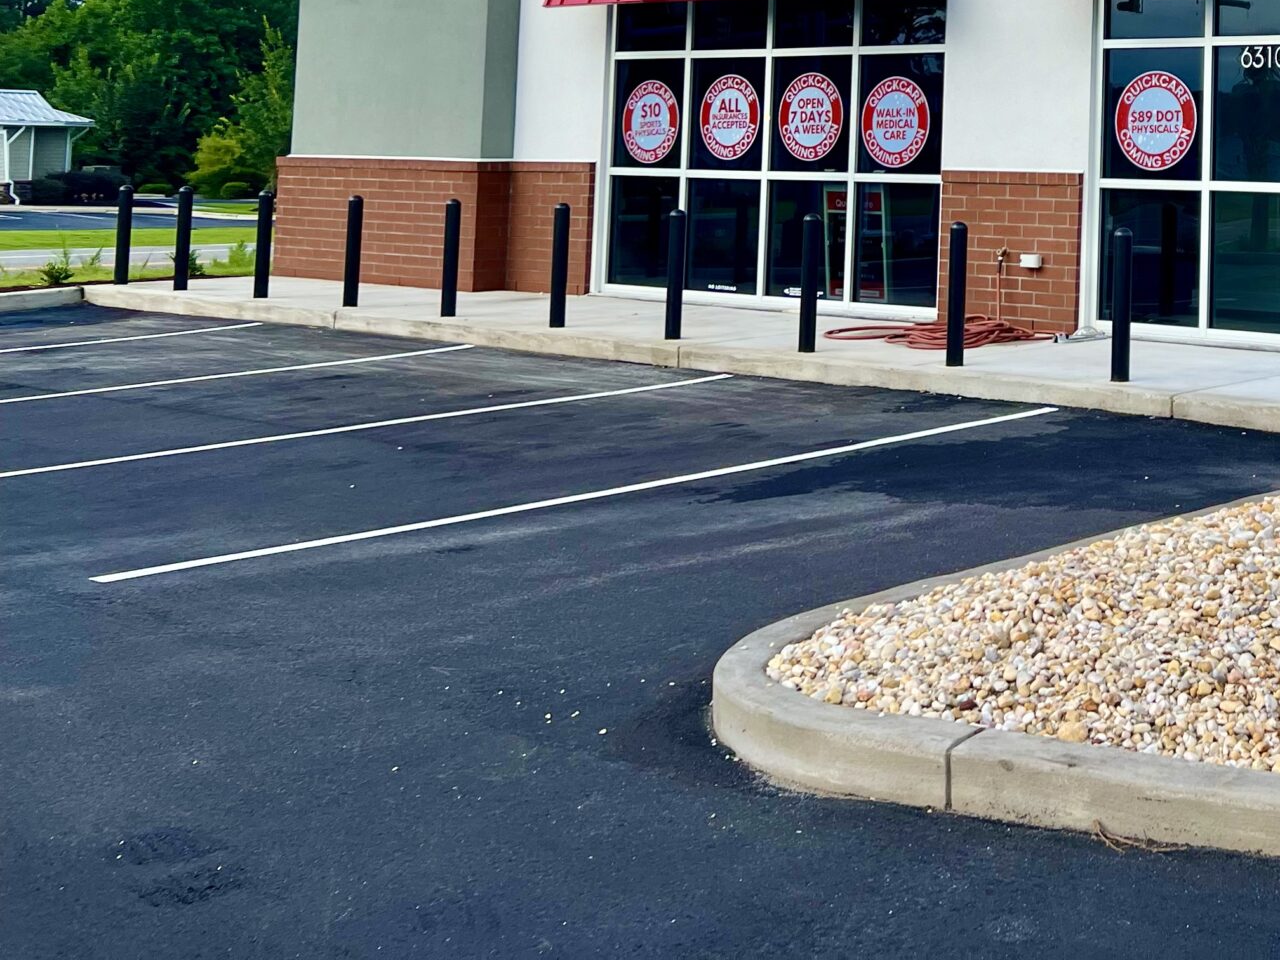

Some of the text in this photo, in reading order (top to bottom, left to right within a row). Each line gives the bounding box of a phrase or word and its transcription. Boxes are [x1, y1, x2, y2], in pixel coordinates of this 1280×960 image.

[628, 83, 675, 110] QUICKCARE
[706, 77, 755, 104] QUICKCARE
[785, 75, 838, 103] QUICKCARE
[869, 78, 926, 108] QUICKCARE
[1123, 74, 1190, 105] QUICKCARE
[641, 102, 661, 120] $10
[718, 98, 741, 113] ALL
[797, 98, 824, 109] OPEN
[790, 110, 831, 123] 7 DAYS
[876, 107, 915, 118] WALK-IN
[1130, 110, 1181, 124] $89 DOT
[640, 121, 662, 129] SPORTS
[711, 120, 748, 130] ACCEPTED
[793, 124, 827, 134] A WEEK
[876, 119, 914, 129] MEDICAL
[1131, 125, 1180, 134] PHYSICALS
[635, 128, 666, 137] PHYSICALS
[703, 123, 756, 157] COMING SOON
[883, 130, 907, 140] CARE
[626, 126, 676, 161] COMING SOON
[782, 123, 839, 159] COMING SOON
[865, 128, 925, 164] COMING SOON
[1120, 128, 1191, 168] COMING SOON
